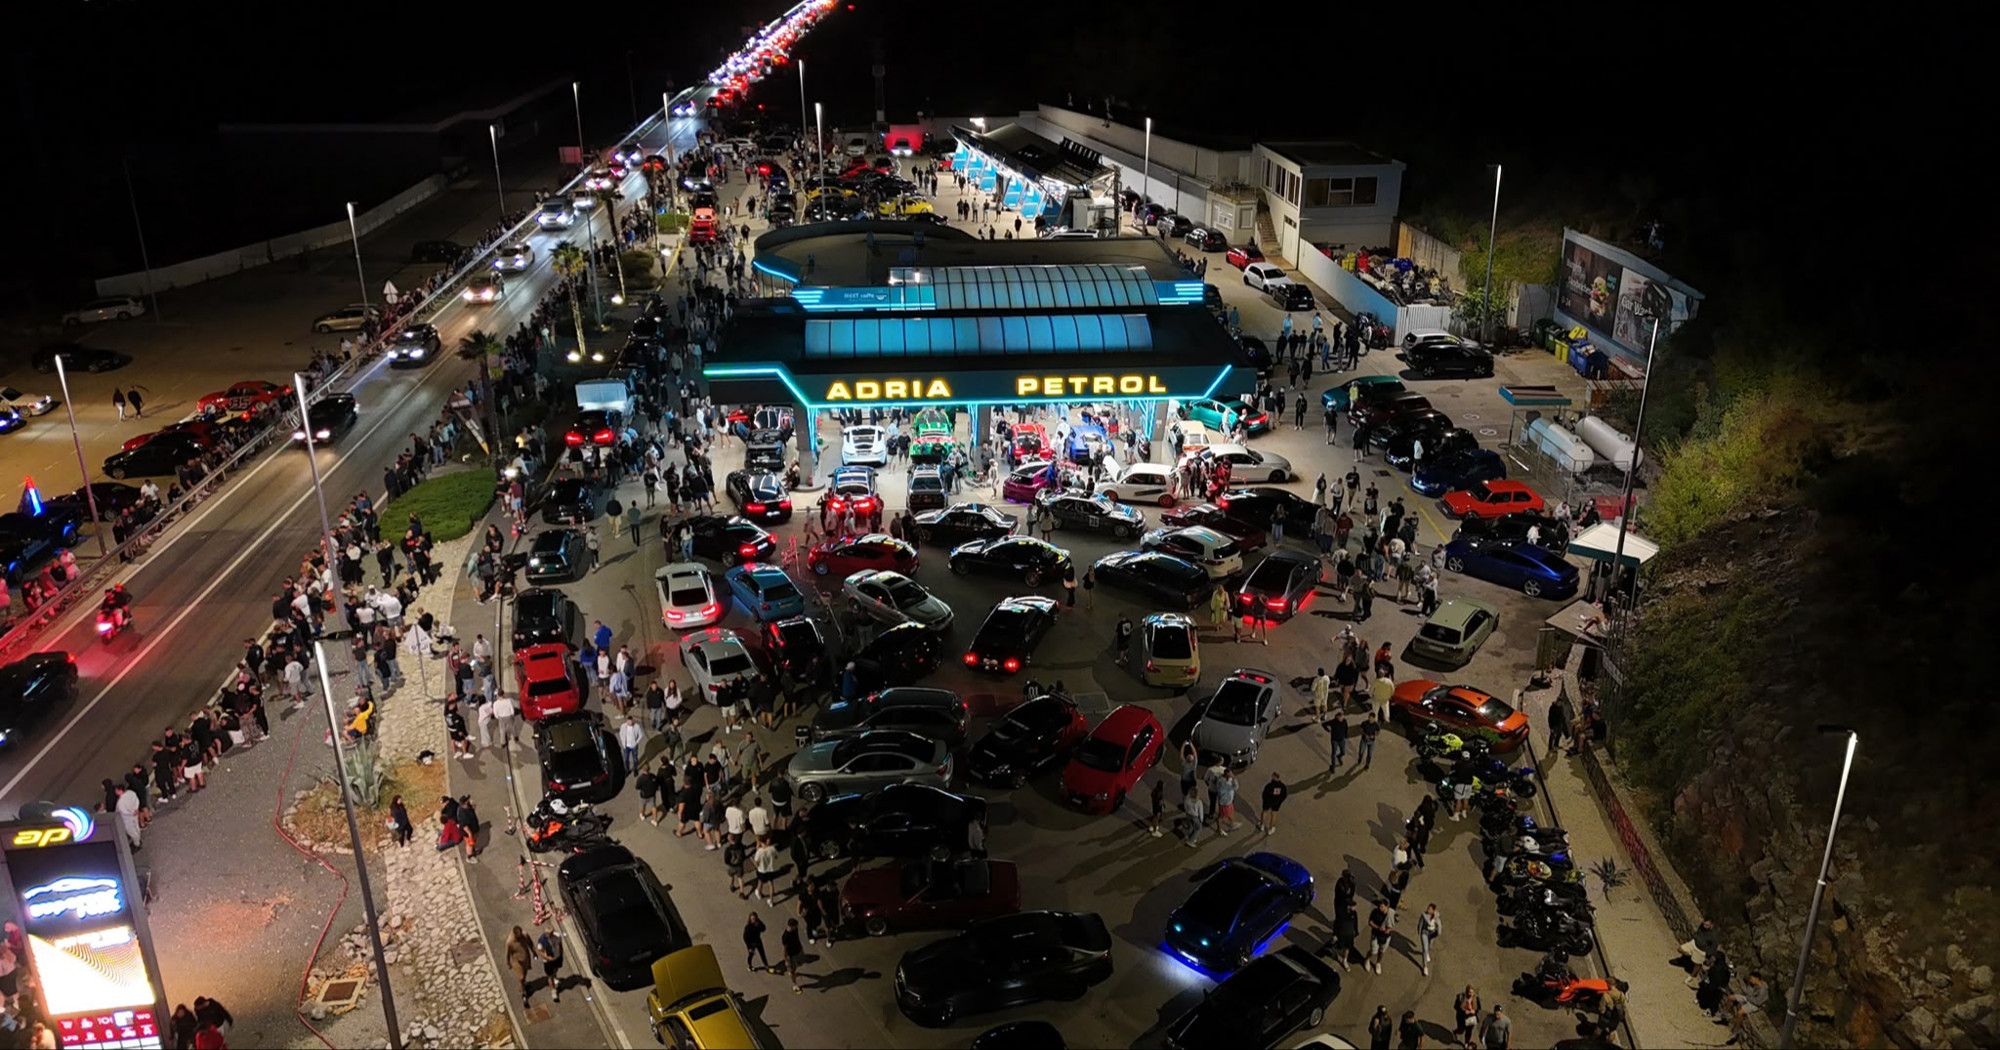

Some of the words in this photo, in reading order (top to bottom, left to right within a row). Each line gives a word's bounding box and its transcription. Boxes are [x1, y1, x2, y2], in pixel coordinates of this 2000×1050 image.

[826, 380, 951, 400] ADRIA
[1017, 375, 1167, 396] PETROL
[13, 827, 71, 847] ap
